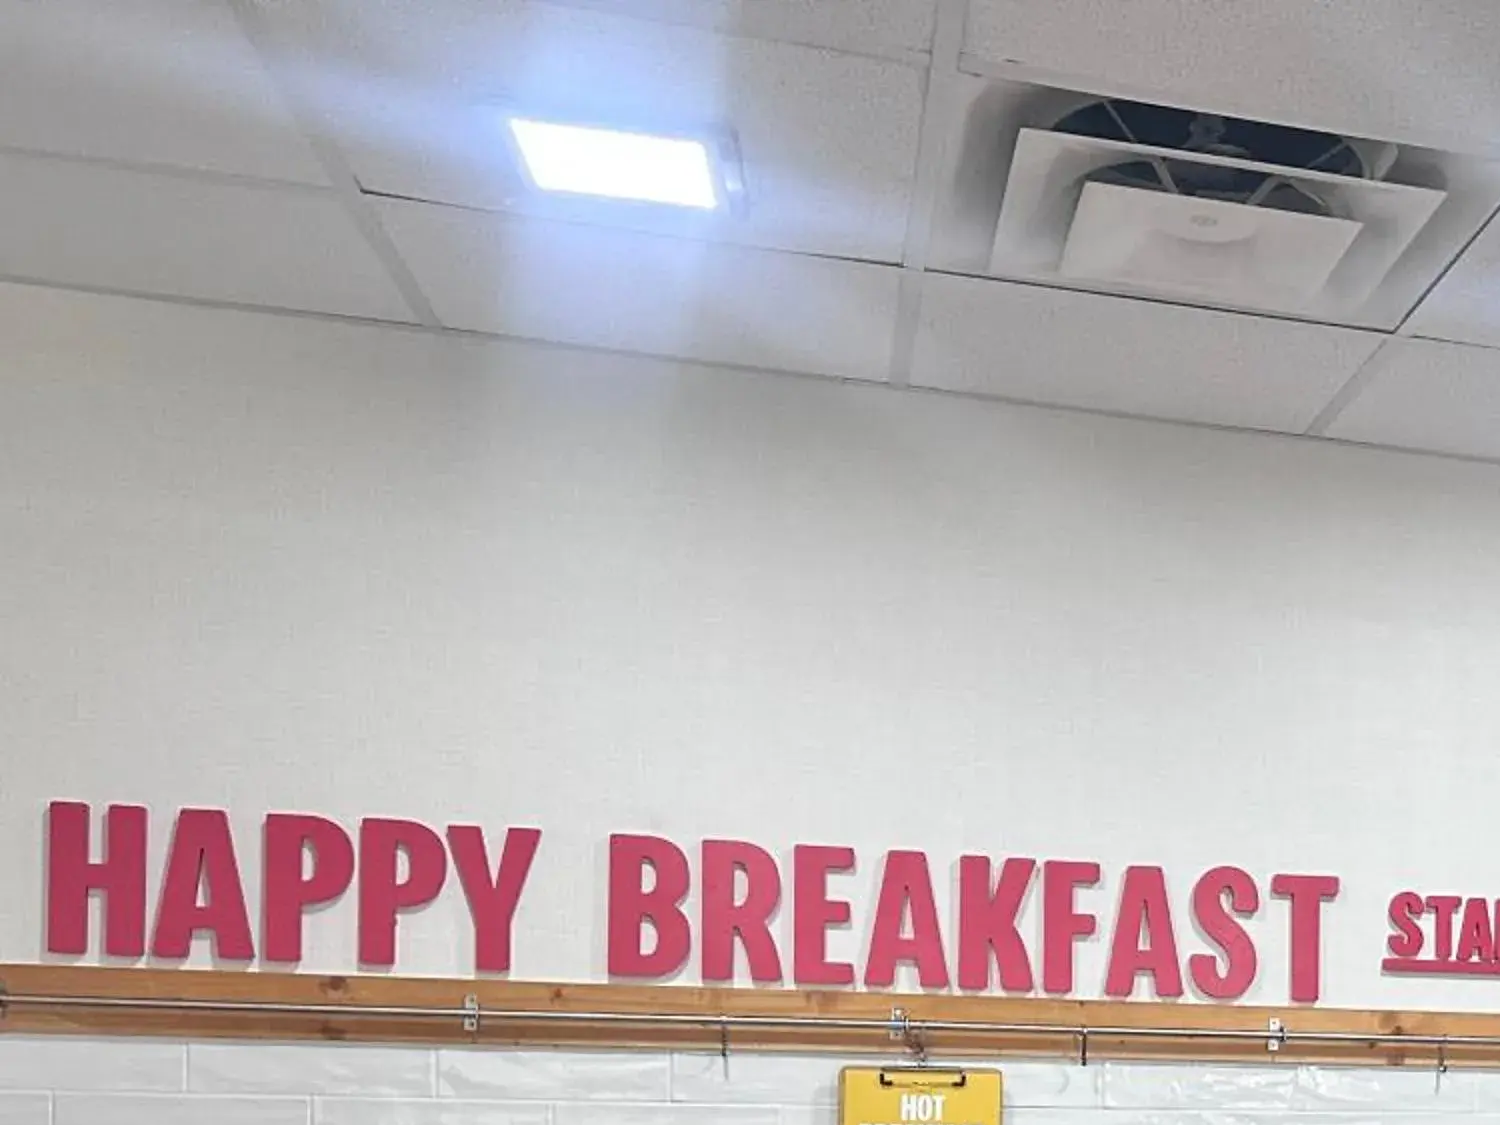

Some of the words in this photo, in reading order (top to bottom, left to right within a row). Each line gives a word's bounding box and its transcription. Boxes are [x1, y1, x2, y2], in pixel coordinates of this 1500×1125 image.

[46, 801, 541, 973] HAPPY
[607, 835, 1339, 1004] BREAKFAST
[901, 1093, 947, 1121] HOT
